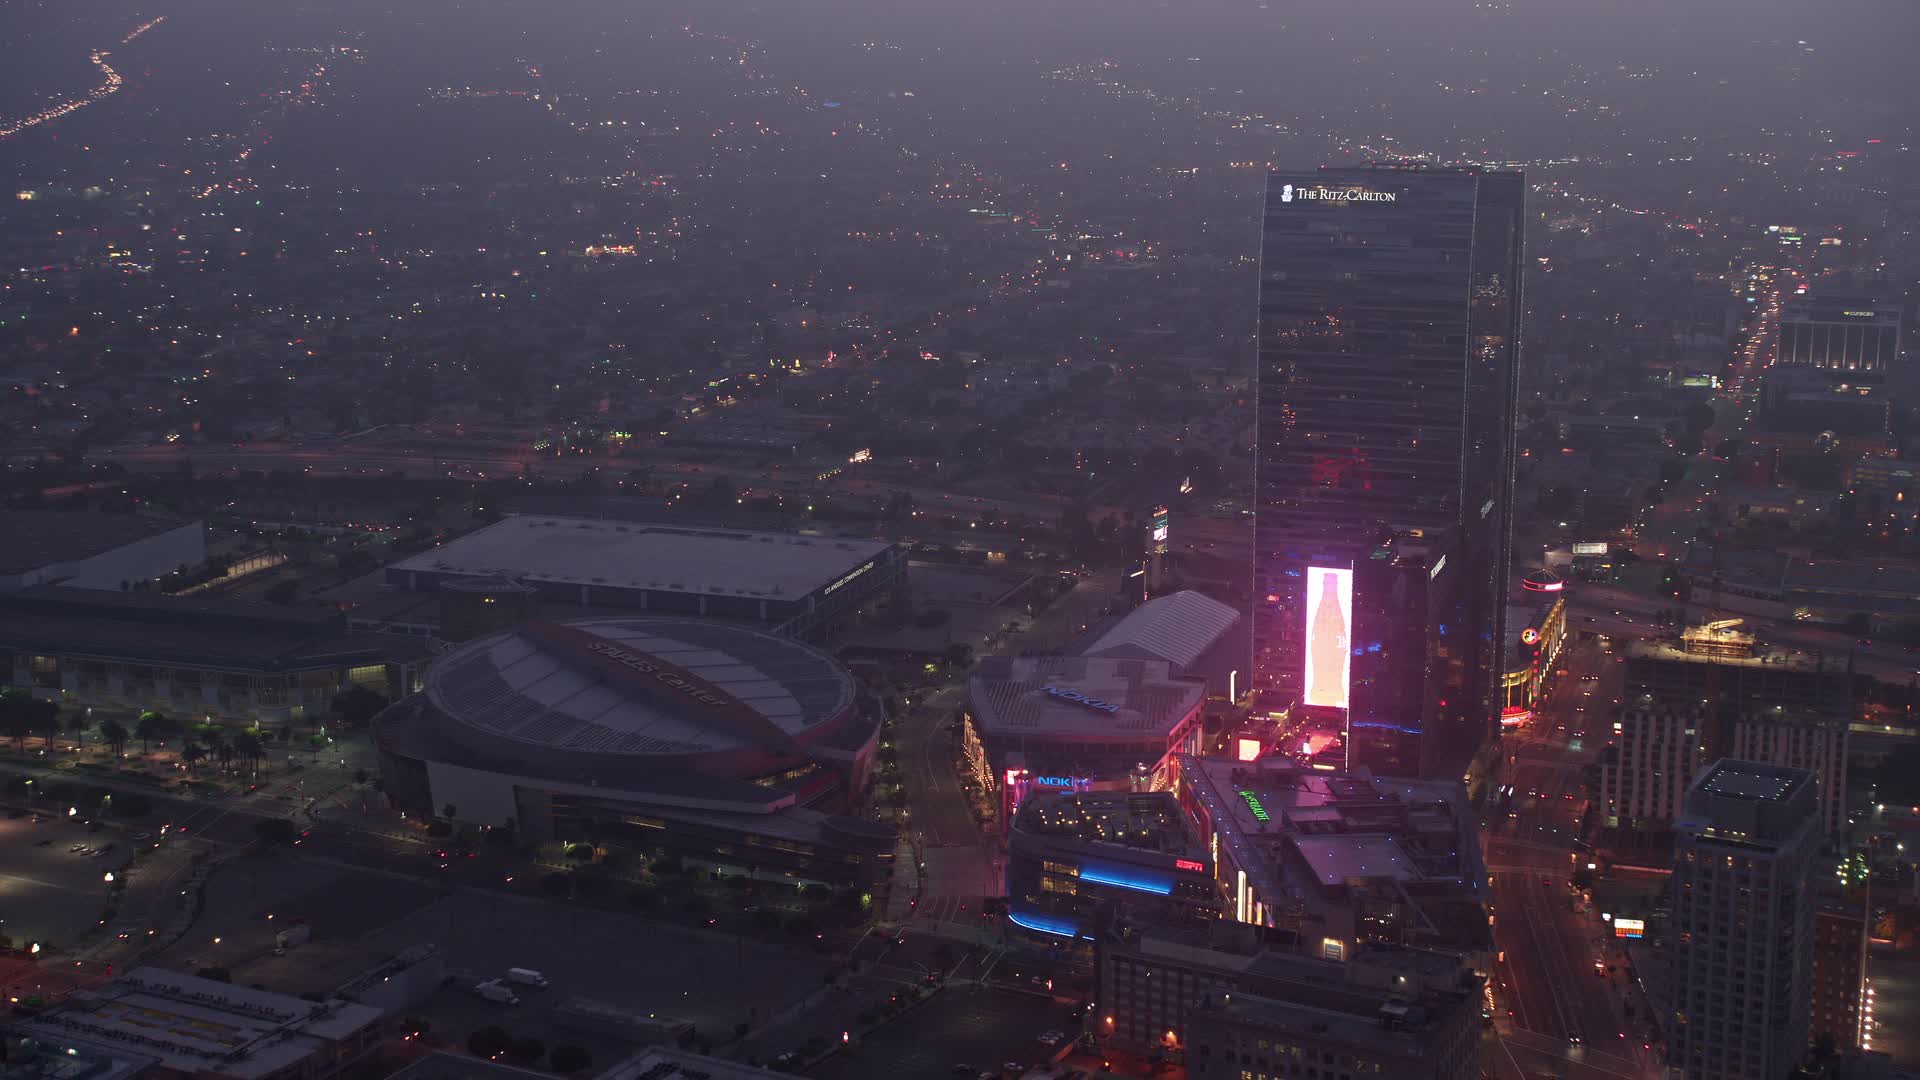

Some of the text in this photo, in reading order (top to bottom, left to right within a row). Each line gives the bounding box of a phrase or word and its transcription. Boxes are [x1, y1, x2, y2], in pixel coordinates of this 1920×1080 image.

[1296, 188, 1396, 202] THE RITZ-CARLTON
[1176, 859, 1204, 871] ESPN
